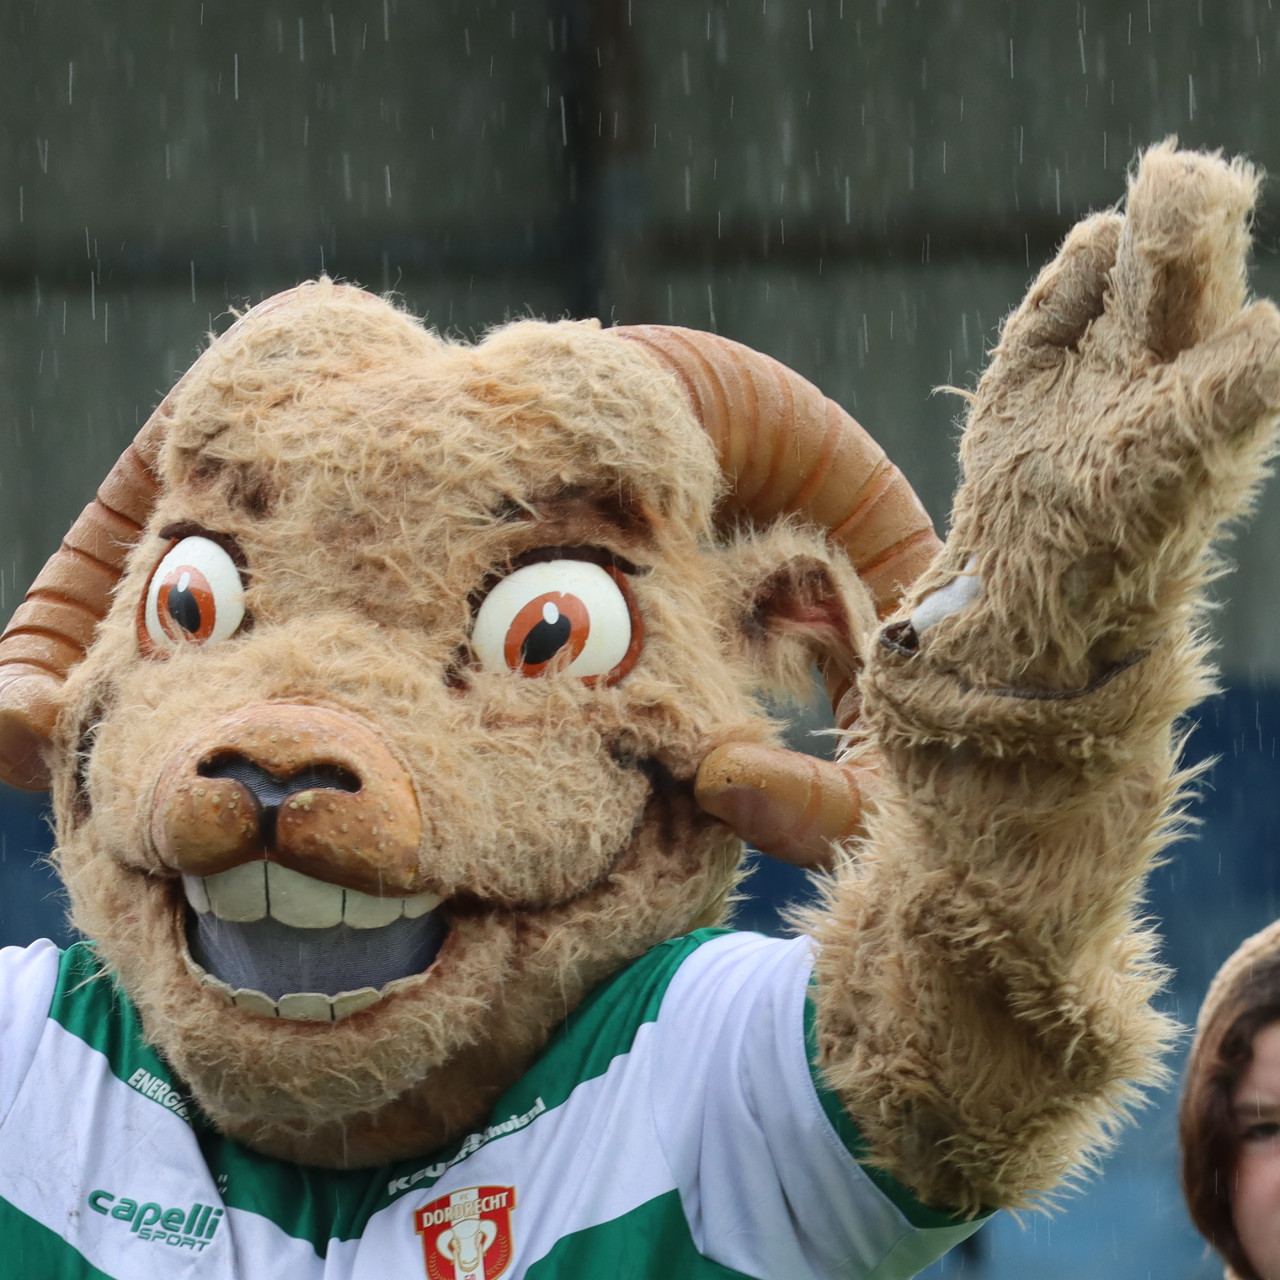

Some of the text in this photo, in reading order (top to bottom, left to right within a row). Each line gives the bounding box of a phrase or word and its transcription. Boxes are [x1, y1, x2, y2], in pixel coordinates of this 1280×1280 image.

[88, 1190, 224, 1239] capelli
[422, 1192, 509, 1228] DORDRECHT
[137, 1227, 210, 1251] SPORT
